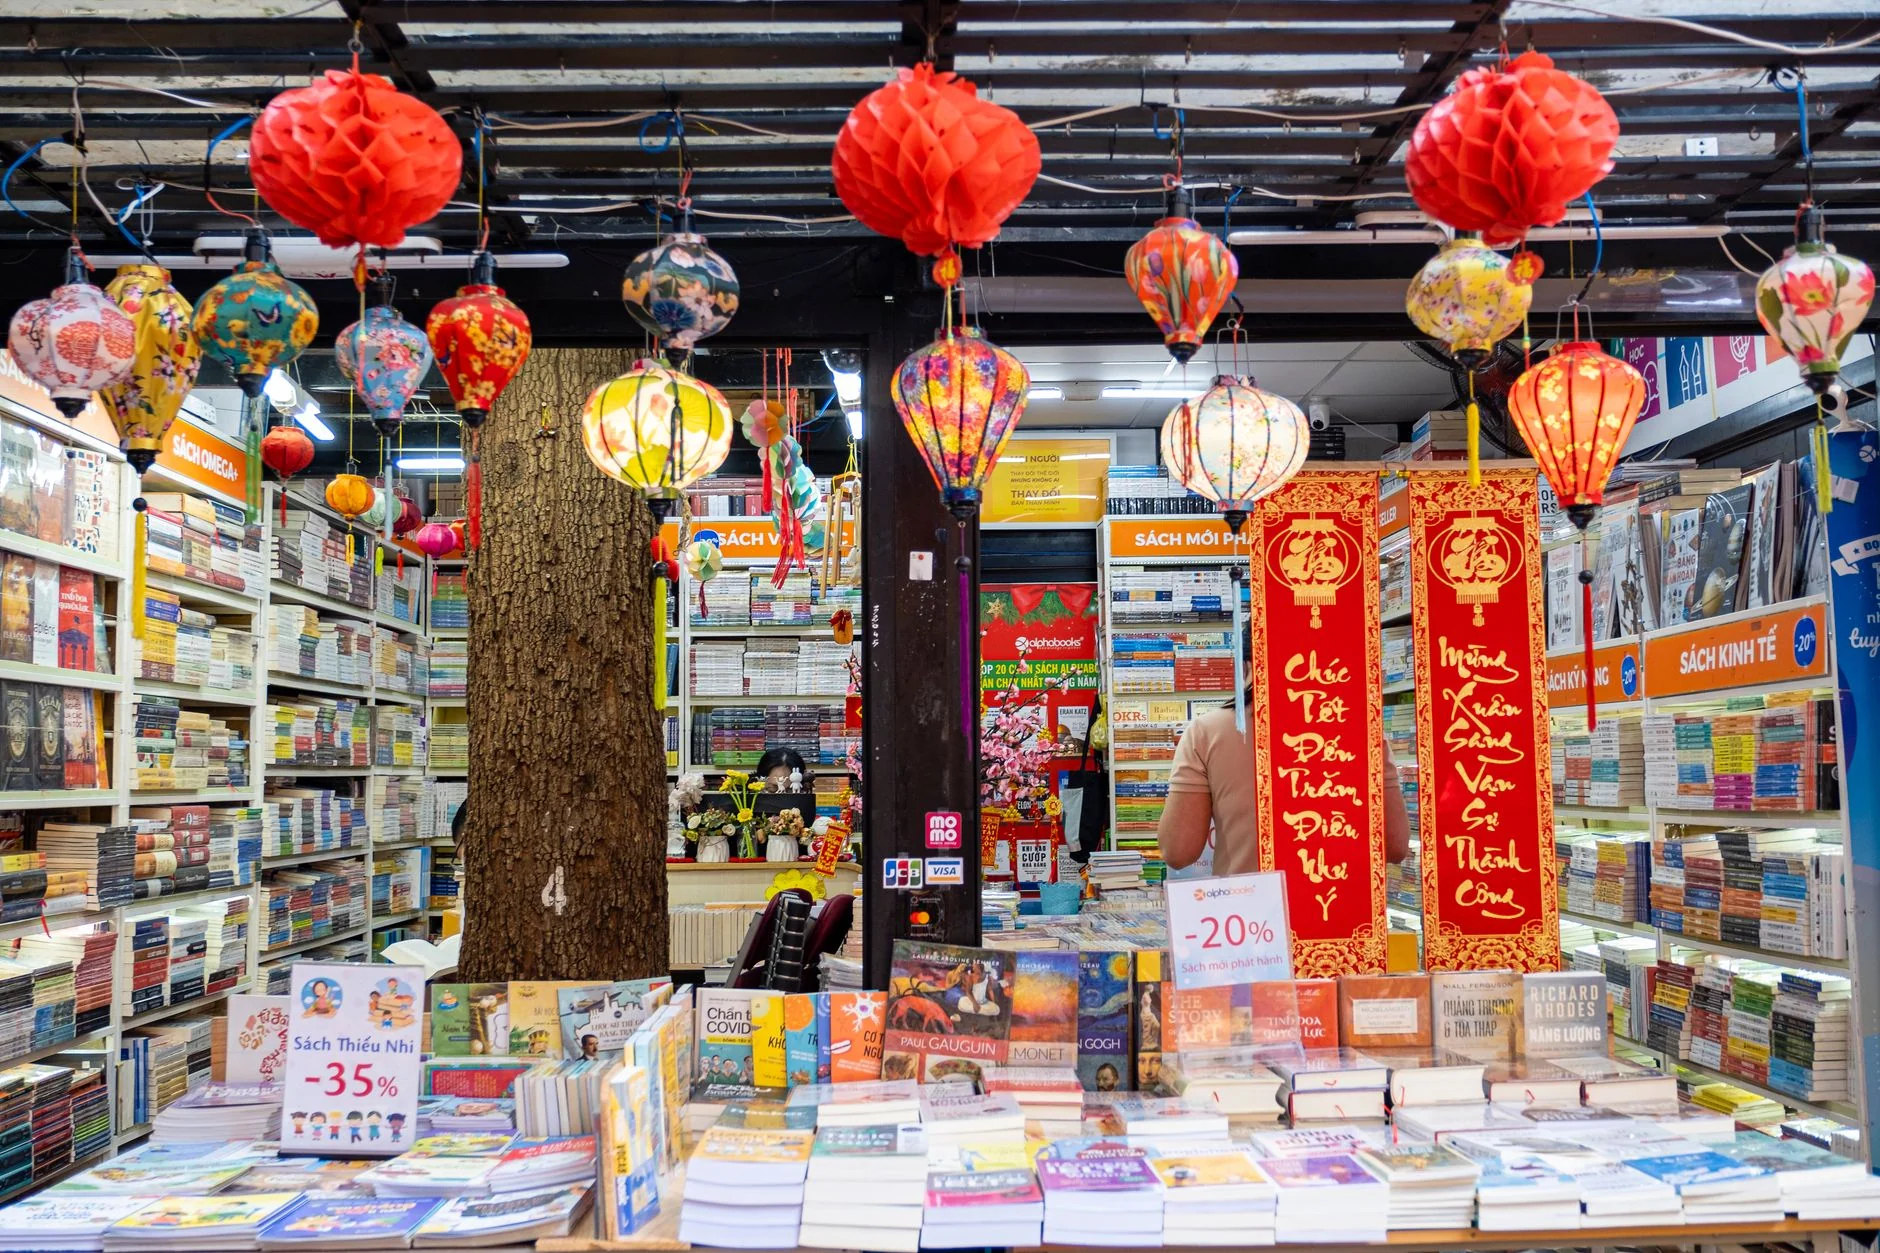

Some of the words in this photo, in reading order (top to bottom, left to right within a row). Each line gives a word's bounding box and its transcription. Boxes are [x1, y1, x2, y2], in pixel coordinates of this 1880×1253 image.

[172, 433, 201, 467] SÁCH
[202, 455, 239, 482] OMEGA+
[1010, 490, 1038, 498] THAY
[719, 529, 765, 546] SÁCH
[1135, 530, 1182, 547] SÁCH
[1185, 529, 1219, 546] MỚI
[1029, 637, 1081, 650] alphabooks
[1680, 642, 1717, 675] SÁCH
[1718, 644, 1754, 671] KINH
[1758, 624, 1778, 661] TẾ
[1794, 632, 1816, 653] -20%
[996, 664, 1006, 674] 20
[1035, 661, 1058, 674] SÁCH
[1284, 650, 1351, 685] Chúc
[1021, 673, 1044, 688] NHẤT
[1078, 674, 1096, 687] NĂM
[1547, 667, 1566, 692] ÁCH
[1581, 666, 1609, 688] NNG
[1286, 688, 1351, 723] Tết
[1442, 681, 1522, 735] Xuân
[1113, 711, 1147, 722] OKRs
[1282, 732, 1356, 763] Đến
[1444, 717, 1524, 764] Sang
[1278, 766, 1363, 806] Trăm
[1455, 760, 1516, 797] Vạn
[1461, 797, 1500, 832] Sự
[1445, 834, 1532, 874] Thành
[933, 867, 957, 876] VISA
[1297, 848, 1349, 884] Như
[1206, 884, 1255, 899] alphabooks
[1455, 879, 1526, 920] Công
[1315, 886, 1337, 921] Ý
[1184, 914, 1274, 949] -20%
[1181, 959, 1206, 974] Sách
[1208, 959, 1229, 972] mới
[1231, 956, 1254, 971] phát
[1256, 953, 1283, 967] hành
[1168, 995, 1202, 1010] THE
[1530, 985, 1599, 1002] RICHARD
[707, 1007, 742, 1020] Chấn
[1443, 996, 1475, 1017] QUẢNG
[1534, 1002, 1596, 1019] RHODES
[1168, 1010, 1222, 1024] STORY
[706, 1021, 750, 1034] COVID
[1176, 1024, 1223, 1043] ART
[1529, 1026, 1561, 1043] NĂNG
[1564, 1026, 1602, 1044] LƯỢNG
[294, 1036, 331, 1051] Sách
[337, 1036, 380, 1052] Thiếu
[386, 1040, 414, 1054] Nhi
[901, 1036, 927, 1049] PAUL
[928, 1036, 996, 1056] GAUGUIN
[1086, 1038, 1121, 1050] GOGH
[1014, 1047, 1065, 1062] MONET
[304, 1062, 398, 1098] -35%
